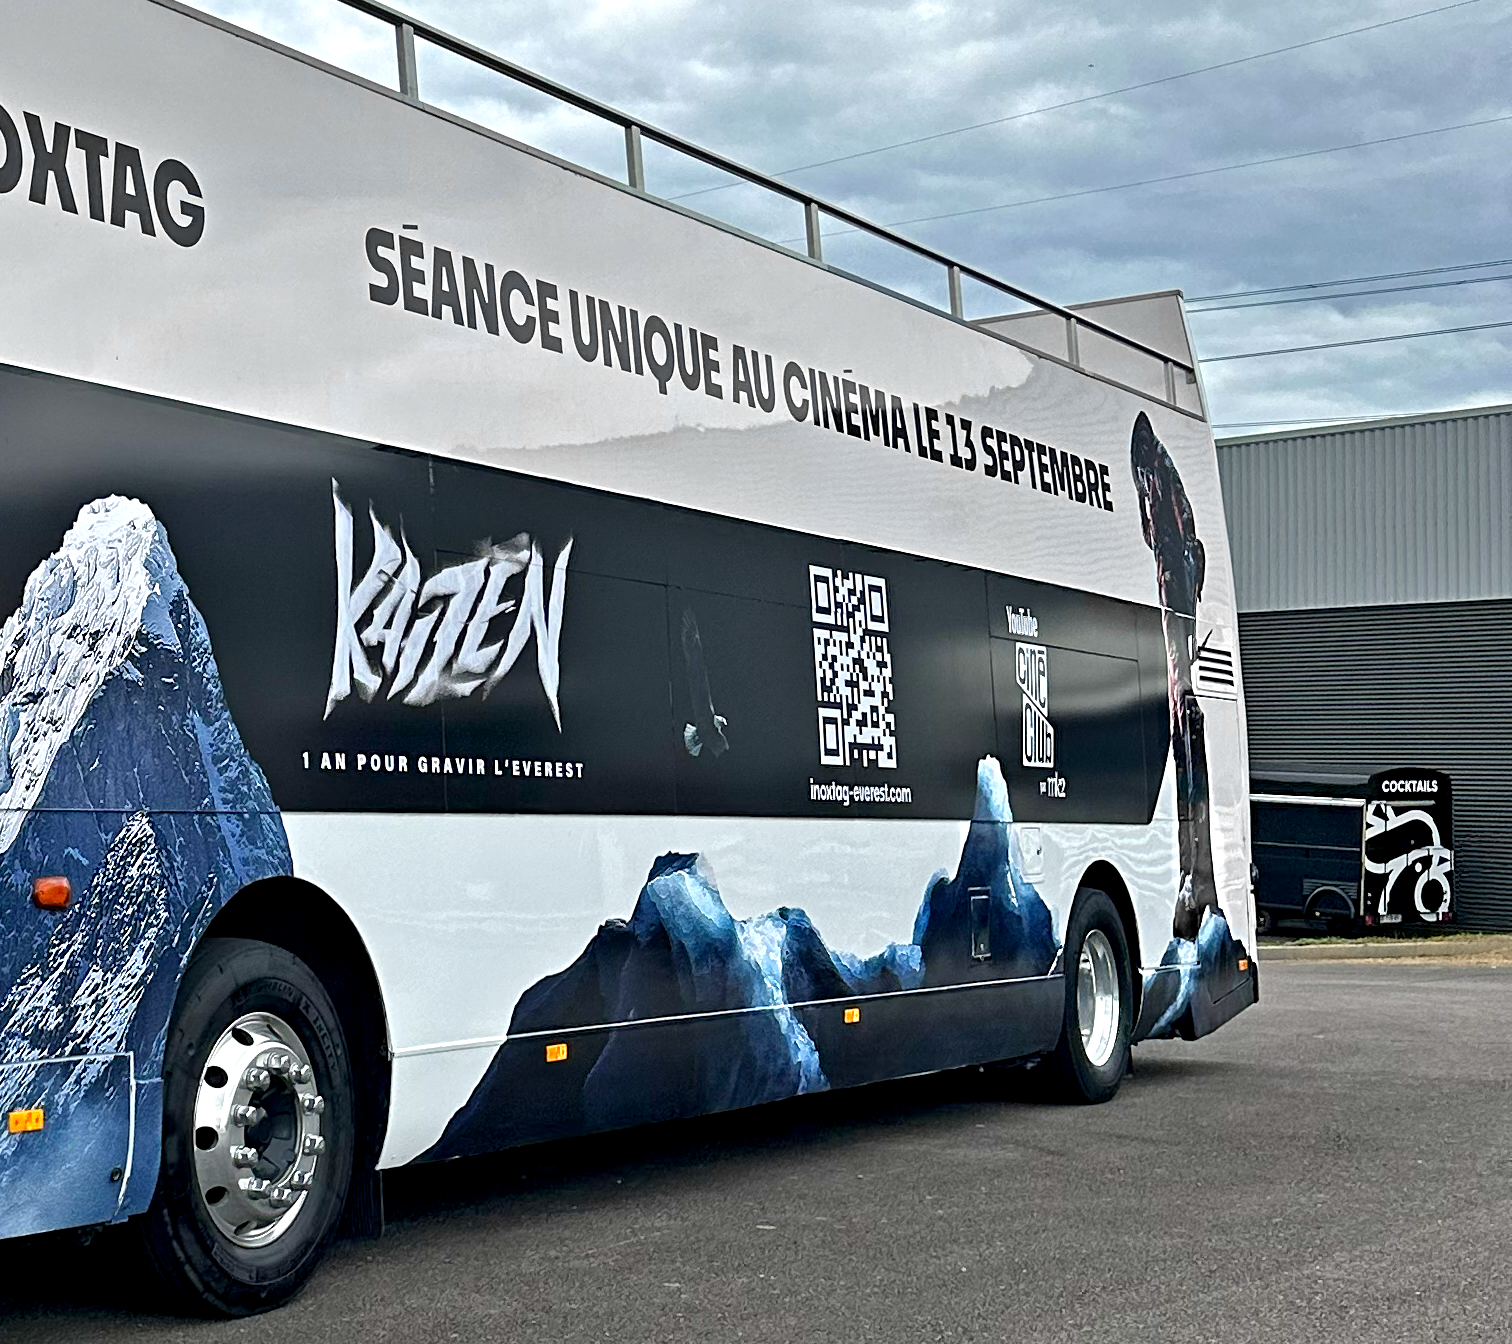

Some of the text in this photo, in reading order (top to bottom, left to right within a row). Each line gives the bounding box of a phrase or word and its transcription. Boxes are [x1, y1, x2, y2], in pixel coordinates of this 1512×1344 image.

[365, 224, 1115, 512] SÉANCE UNIQUE AU CINÉMA LE 13 SEPTEMBRE
[1005, 606, 1038, 638] YouTube
[302, 751, 584, 778] 1 AN POUR GRAVIR L'EVEREST
[809, 777, 913, 807] inoxtag-everest.com
[1382, 780, 1438, 793] COCKTAILS
